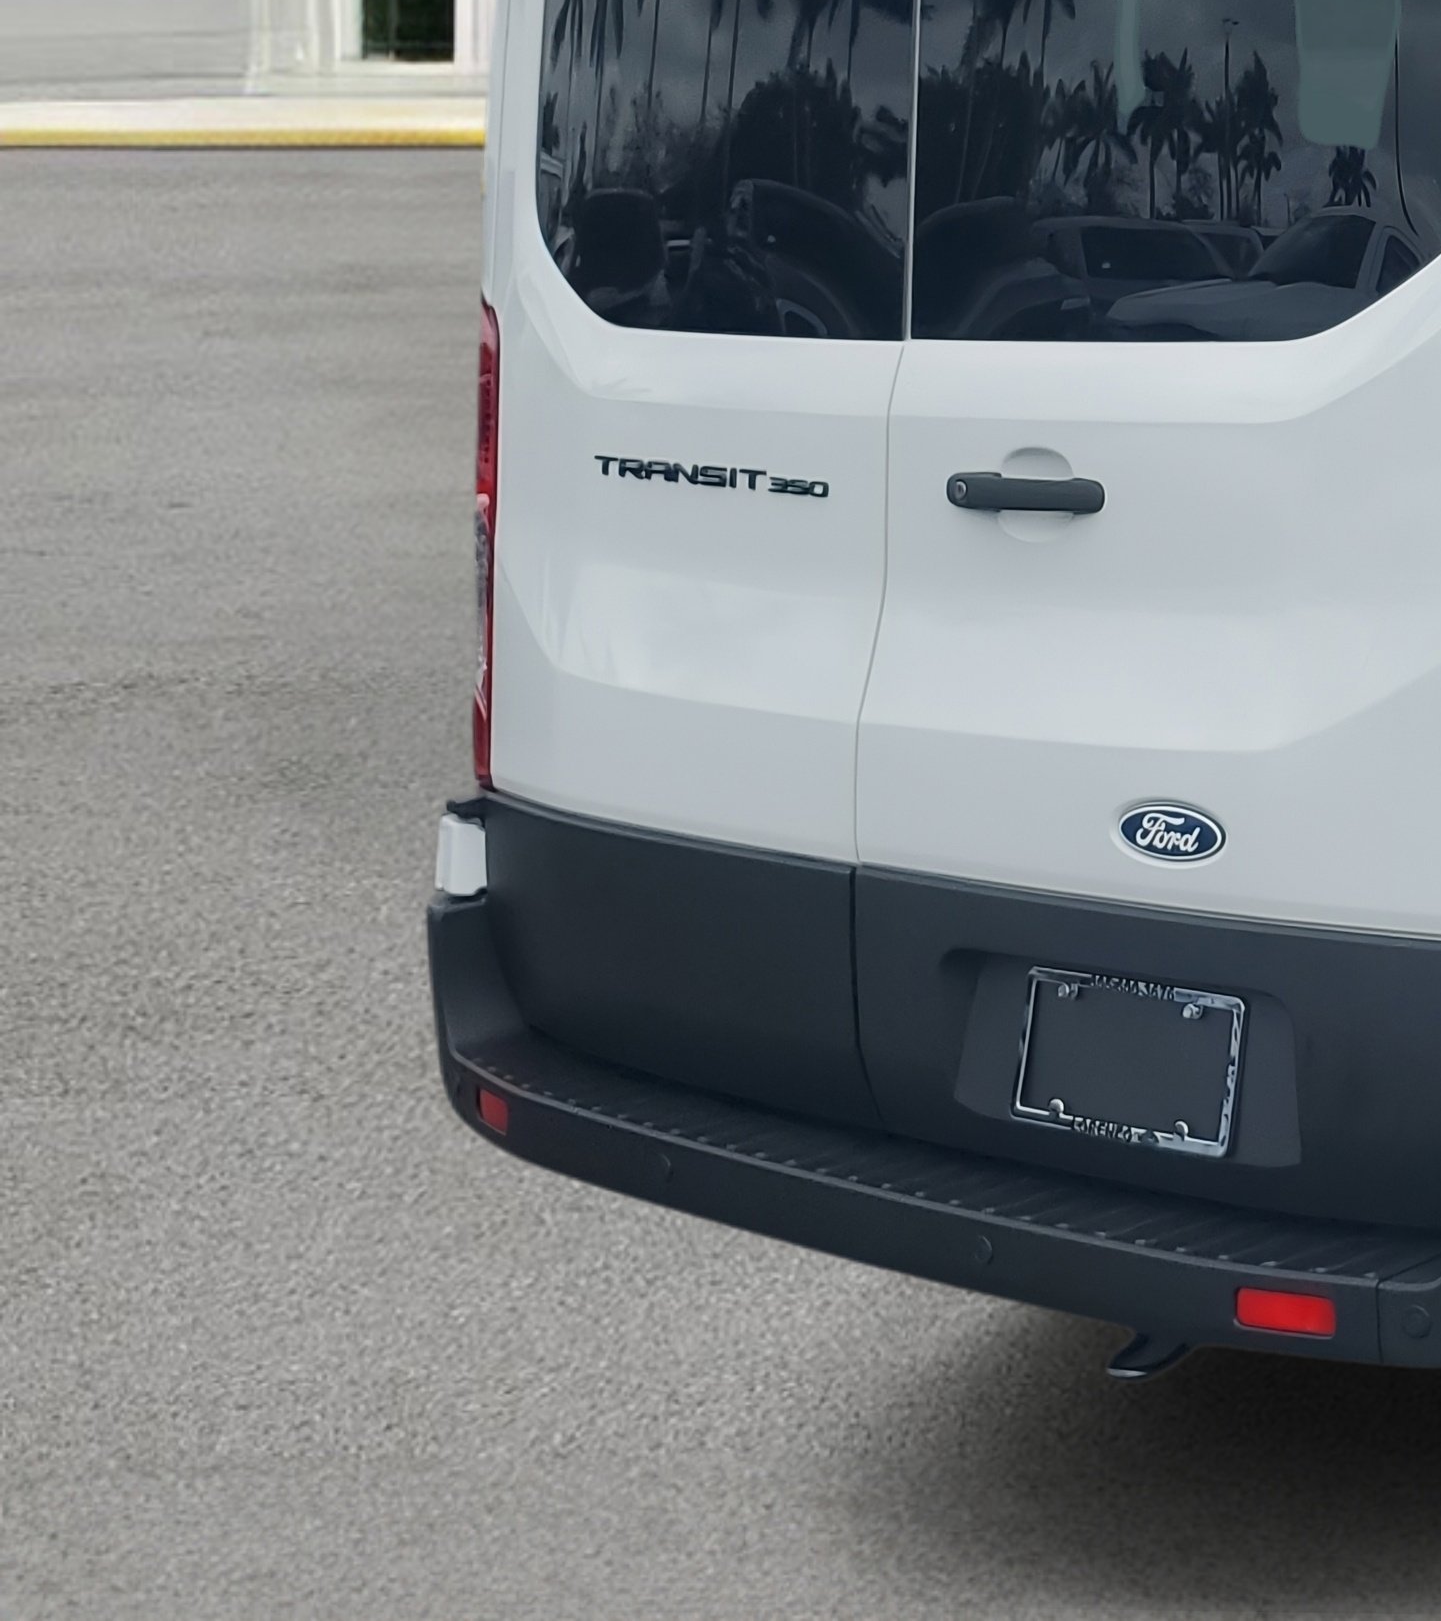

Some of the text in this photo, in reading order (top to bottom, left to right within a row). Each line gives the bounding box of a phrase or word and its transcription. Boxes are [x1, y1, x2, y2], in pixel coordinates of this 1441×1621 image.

[594, 454, 829, 499] TRANSIT 350
[1135, 812, 1201, 853] Ford
